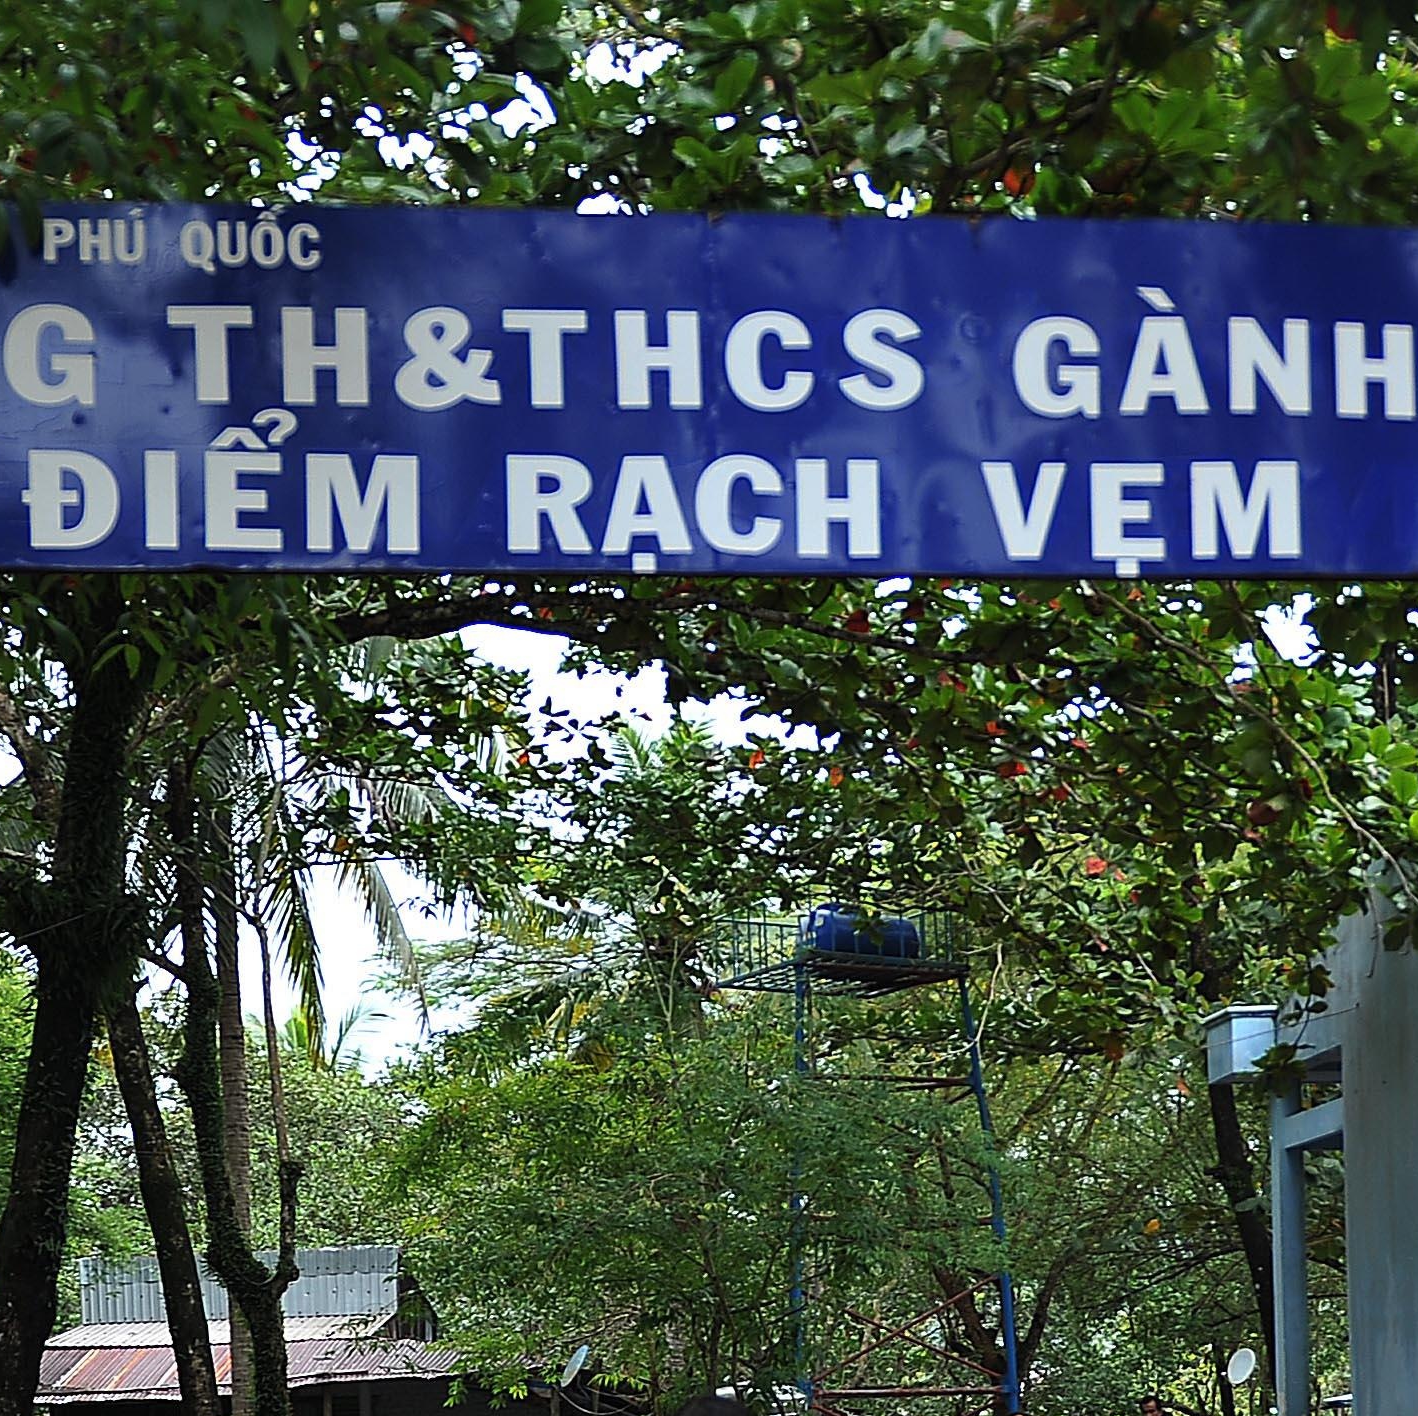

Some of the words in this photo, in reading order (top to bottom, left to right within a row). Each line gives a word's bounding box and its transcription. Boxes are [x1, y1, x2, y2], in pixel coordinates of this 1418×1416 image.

[43, 207, 146, 264] PHÚ
[181, 204, 321, 275] QUỐC
[167, 305, 924, 411] TH&THCS
[1012, 286, 1417, 421] GÀNH
[21, 408, 422, 554] ĐIỂM
[505, 454, 882, 574] RẠCH
[981, 460, 1302, 578] VẸM
